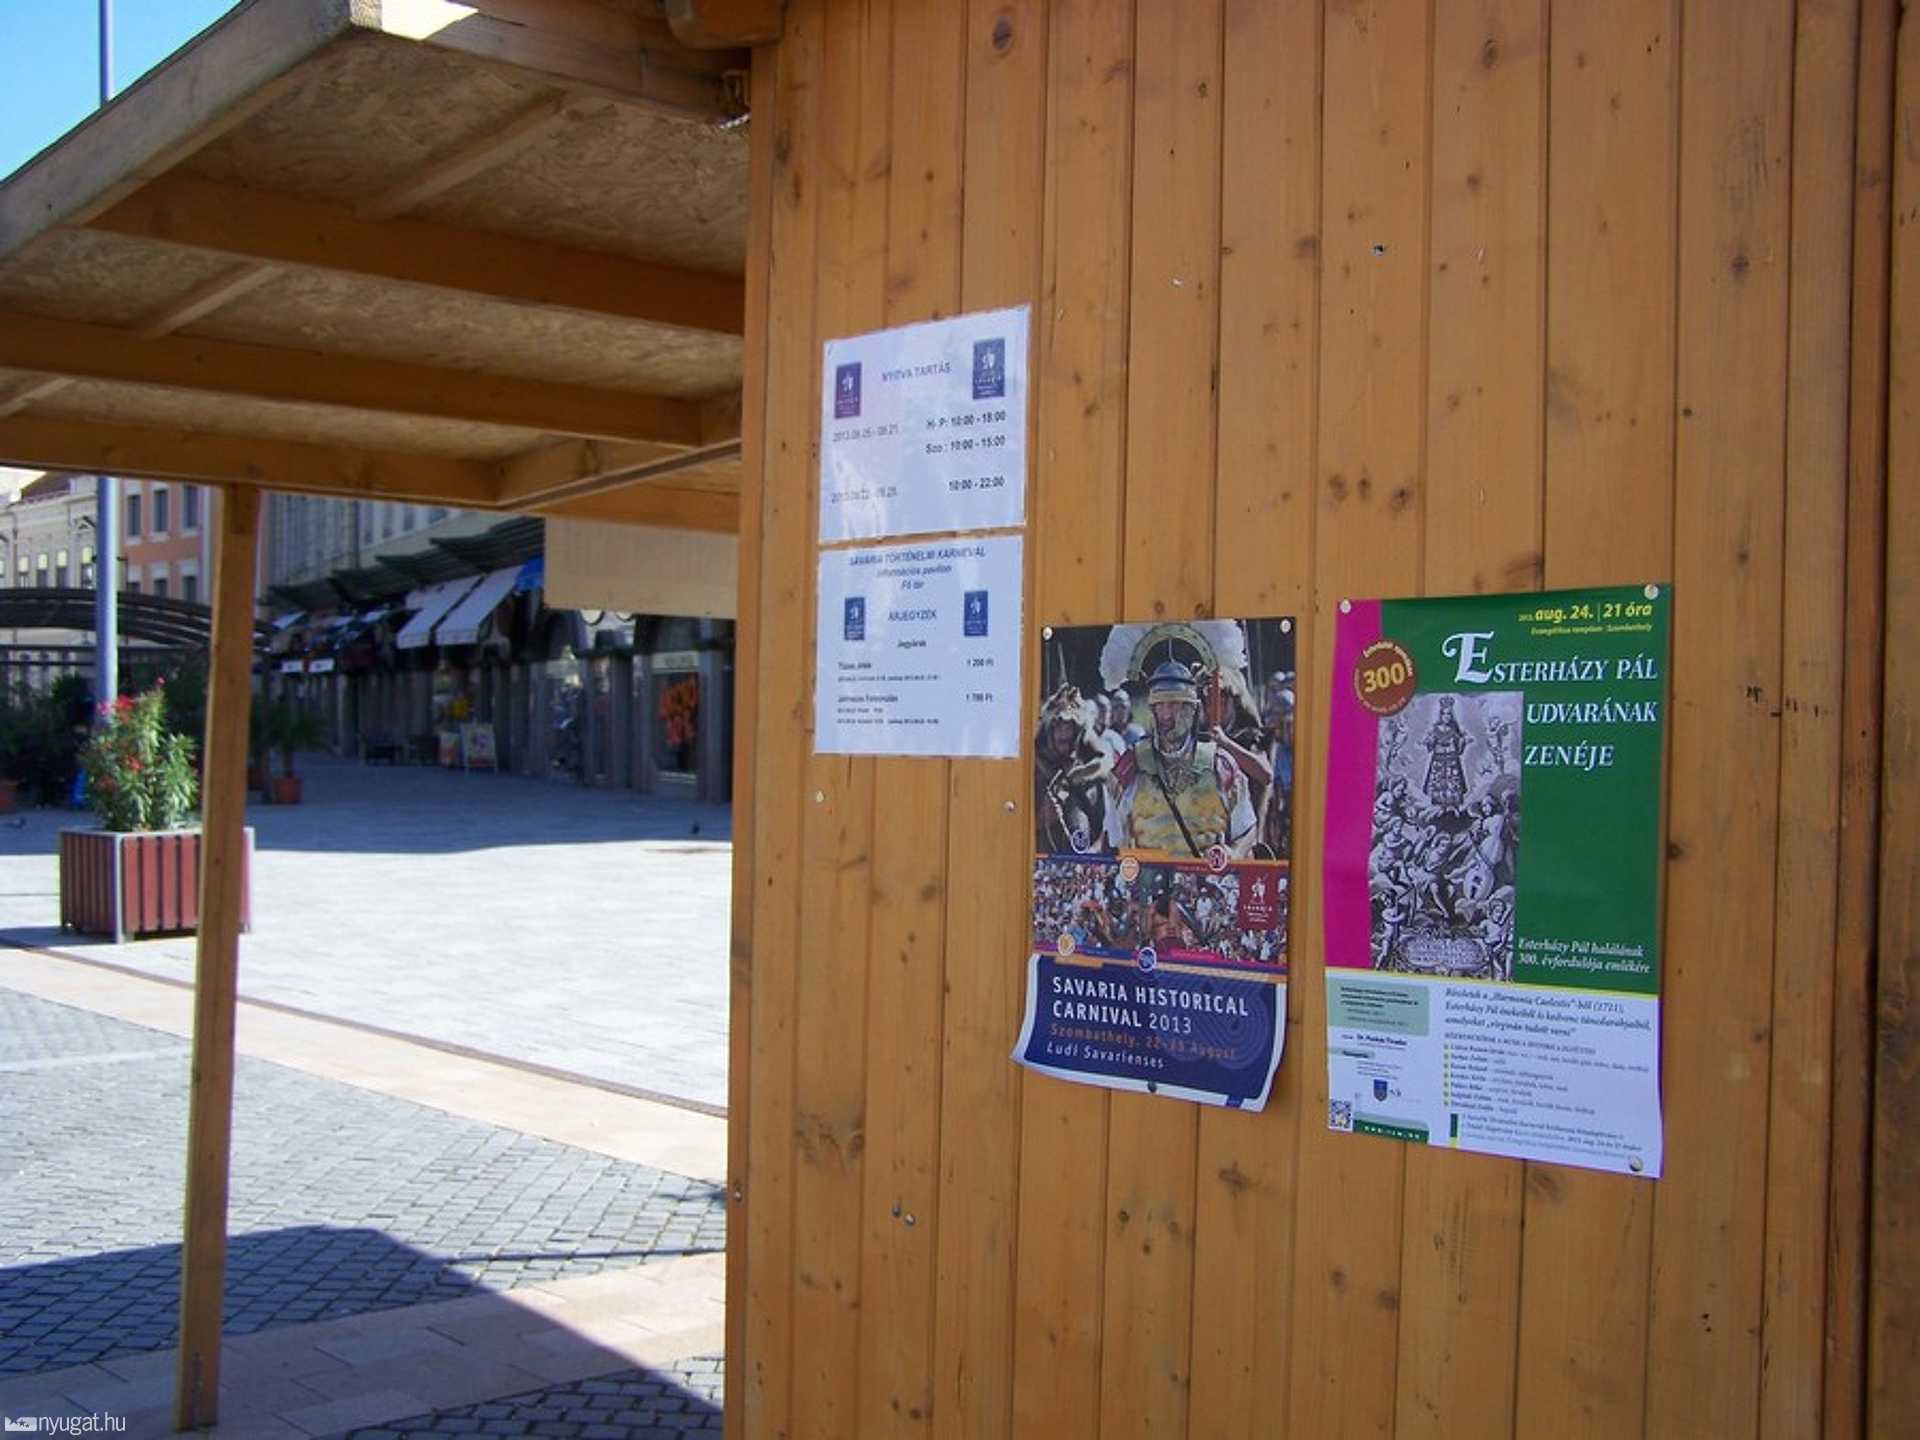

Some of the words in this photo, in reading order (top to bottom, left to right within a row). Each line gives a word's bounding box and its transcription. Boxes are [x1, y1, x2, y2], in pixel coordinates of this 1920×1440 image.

[1535, 608, 1567, 624] aug.
[1569, 604, 1594, 620] 24.
[1602, 603, 1622, 618] 21
[1624, 601, 1653, 617] óra
[1441, 631, 1607, 684] ESTERHÁZY
[1616, 653, 1657, 680] PÁL
[1362, 662, 1406, 693] 300
[1526, 697, 1657, 724] UDVARÁNAK
[1524, 740, 1614, 771] ZENÉJE
[1052, 976, 1128, 1002] SAVARIA
[1135, 986, 1249, 1017] HISTORICAL
[1052, 1000, 1142, 1028] CARNIVAL
[1149, 1012, 1192, 1034] 2013
[1046, 1041, 1079, 1057] Ludi
[1083, 1045, 1164, 1069] Savarienses
